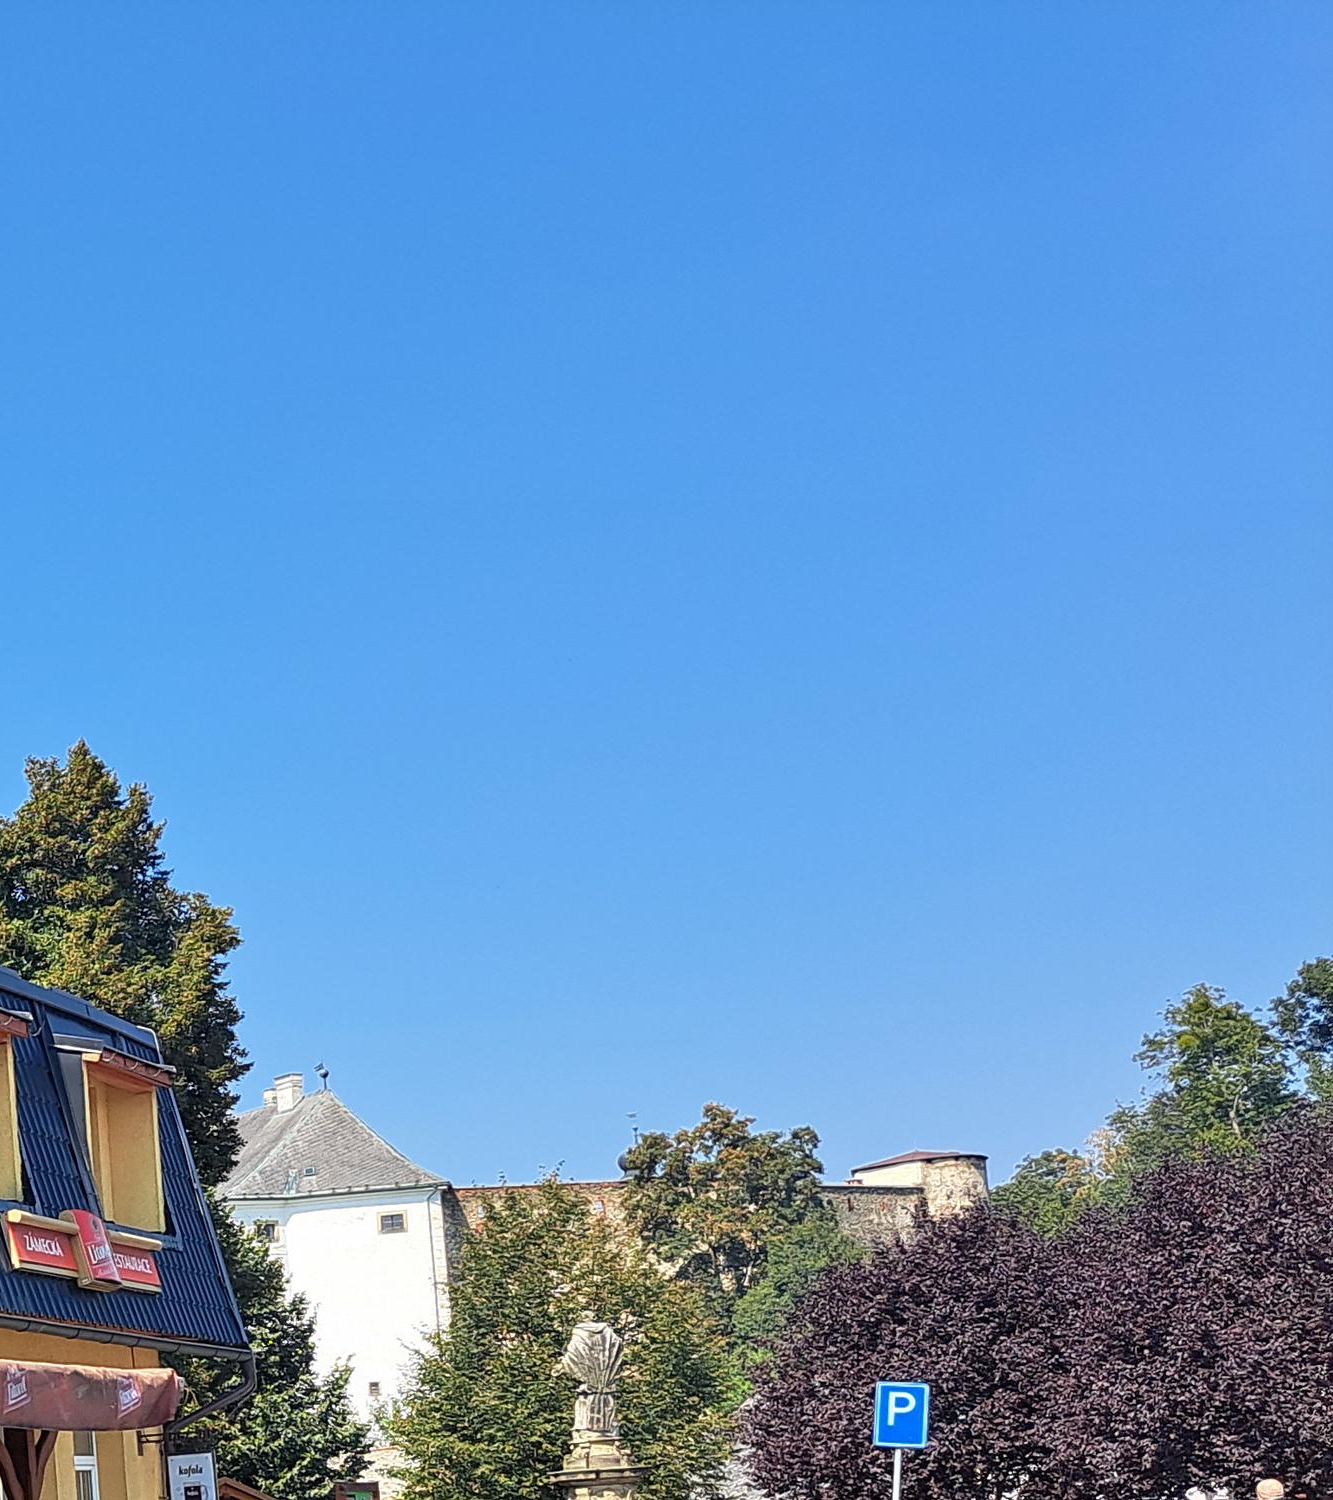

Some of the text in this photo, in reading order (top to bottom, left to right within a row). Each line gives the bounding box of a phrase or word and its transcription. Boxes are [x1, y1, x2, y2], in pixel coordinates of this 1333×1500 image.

[23, 1231, 64, 1257] ZÁMECKÁ
[113, 1253, 153, 1275] ESTAURACE
[887, 1391, 916, 1426] P
[178, 1464, 203, 1477] kofola
